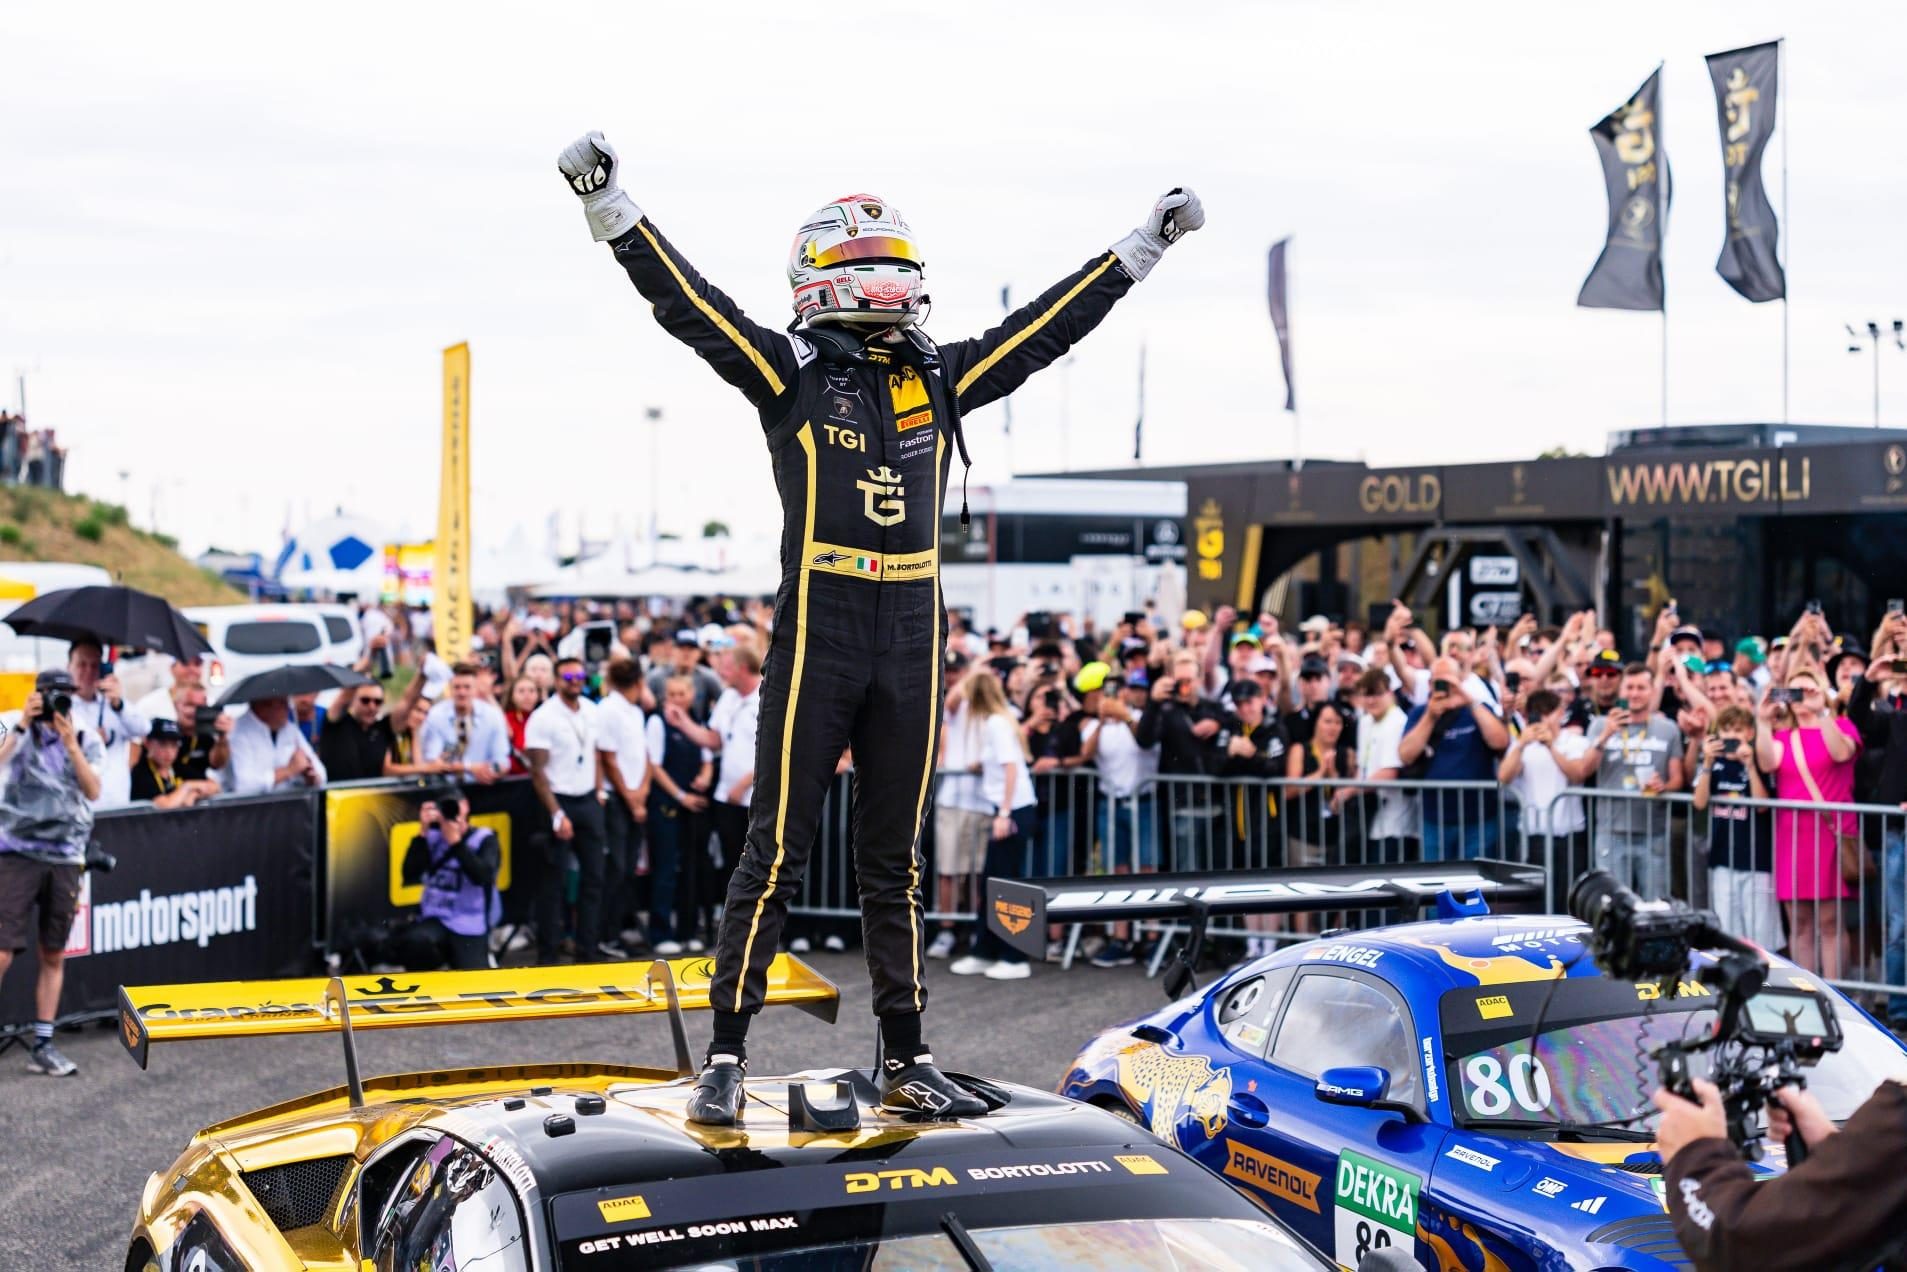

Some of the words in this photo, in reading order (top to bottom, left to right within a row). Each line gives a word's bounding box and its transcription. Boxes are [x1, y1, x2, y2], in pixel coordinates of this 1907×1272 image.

[836, 276, 852, 284] BELL
[900, 412, 930, 430] PIRELLI
[823, 424, 866, 453] TGI
[900, 434, 934, 449] Fastron
[1607, 456, 1811, 505] WWW.TGI.LI
[1359, 473, 1442, 513] GOLD
[897, 559, 932, 571] BORTOLOTTI
[93, 874, 258, 954] motorsport
[1321, 945, 1385, 968] ENGEL
[1635, 980, 1711, 1000] DM
[1478, 997, 1506, 1008] ADAC
[1328, 1086, 1364, 1097] AMG
[1466, 1053, 1552, 1116] 80
[1452, 1148, 1492, 1168] RAVENOL
[844, 1166, 959, 1194] DTM
[967, 1160, 1112, 1182] BORTOLOTTI
[1233, 1151, 1312, 1200] RAVENOL
[1337, 1159, 1414, 1226] DEKRA
[1535, 1179, 1565, 1196] OMP
[602, 1198, 643, 1209] ADAC
[579, 1237, 622, 1254] GET
[625, 1229, 685, 1247] WELL
[687, 1221, 748, 1238] SOON
[749, 1216, 799, 1232] MAX
